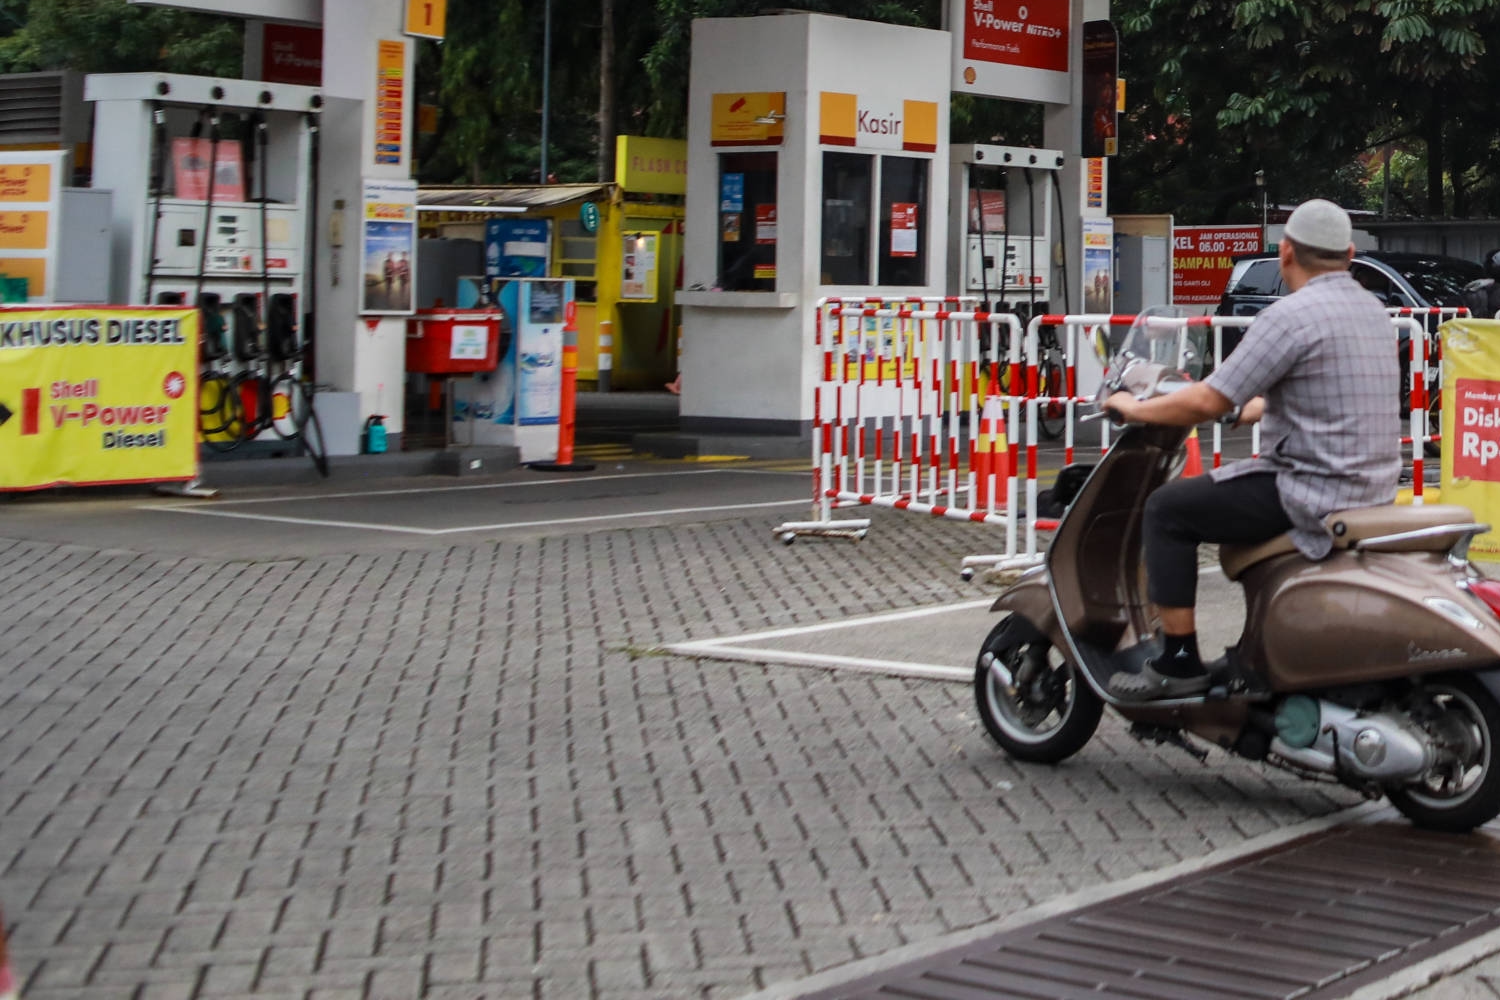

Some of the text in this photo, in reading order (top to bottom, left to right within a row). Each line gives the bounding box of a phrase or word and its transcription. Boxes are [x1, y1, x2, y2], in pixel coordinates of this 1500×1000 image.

[424, 3, 433, 26] 1
[973, 10, 1062, 39] V-Power NITRO+
[971, 38, 1020, 54] Performance Fuels
[858, 110, 902, 135] Kasir
[1199, 231, 1259, 241] JAM OPERASIONAL
[1233, 241, 1258, 252] 22.00
[1173, 256, 1215, 269] SAMPAI
[0, 318, 185, 348] KHUSUS DIESEL
[50, 378, 98, 399] Shell
[50, 402, 169, 429] V-Power
[102, 429, 165, 449] Diesel
